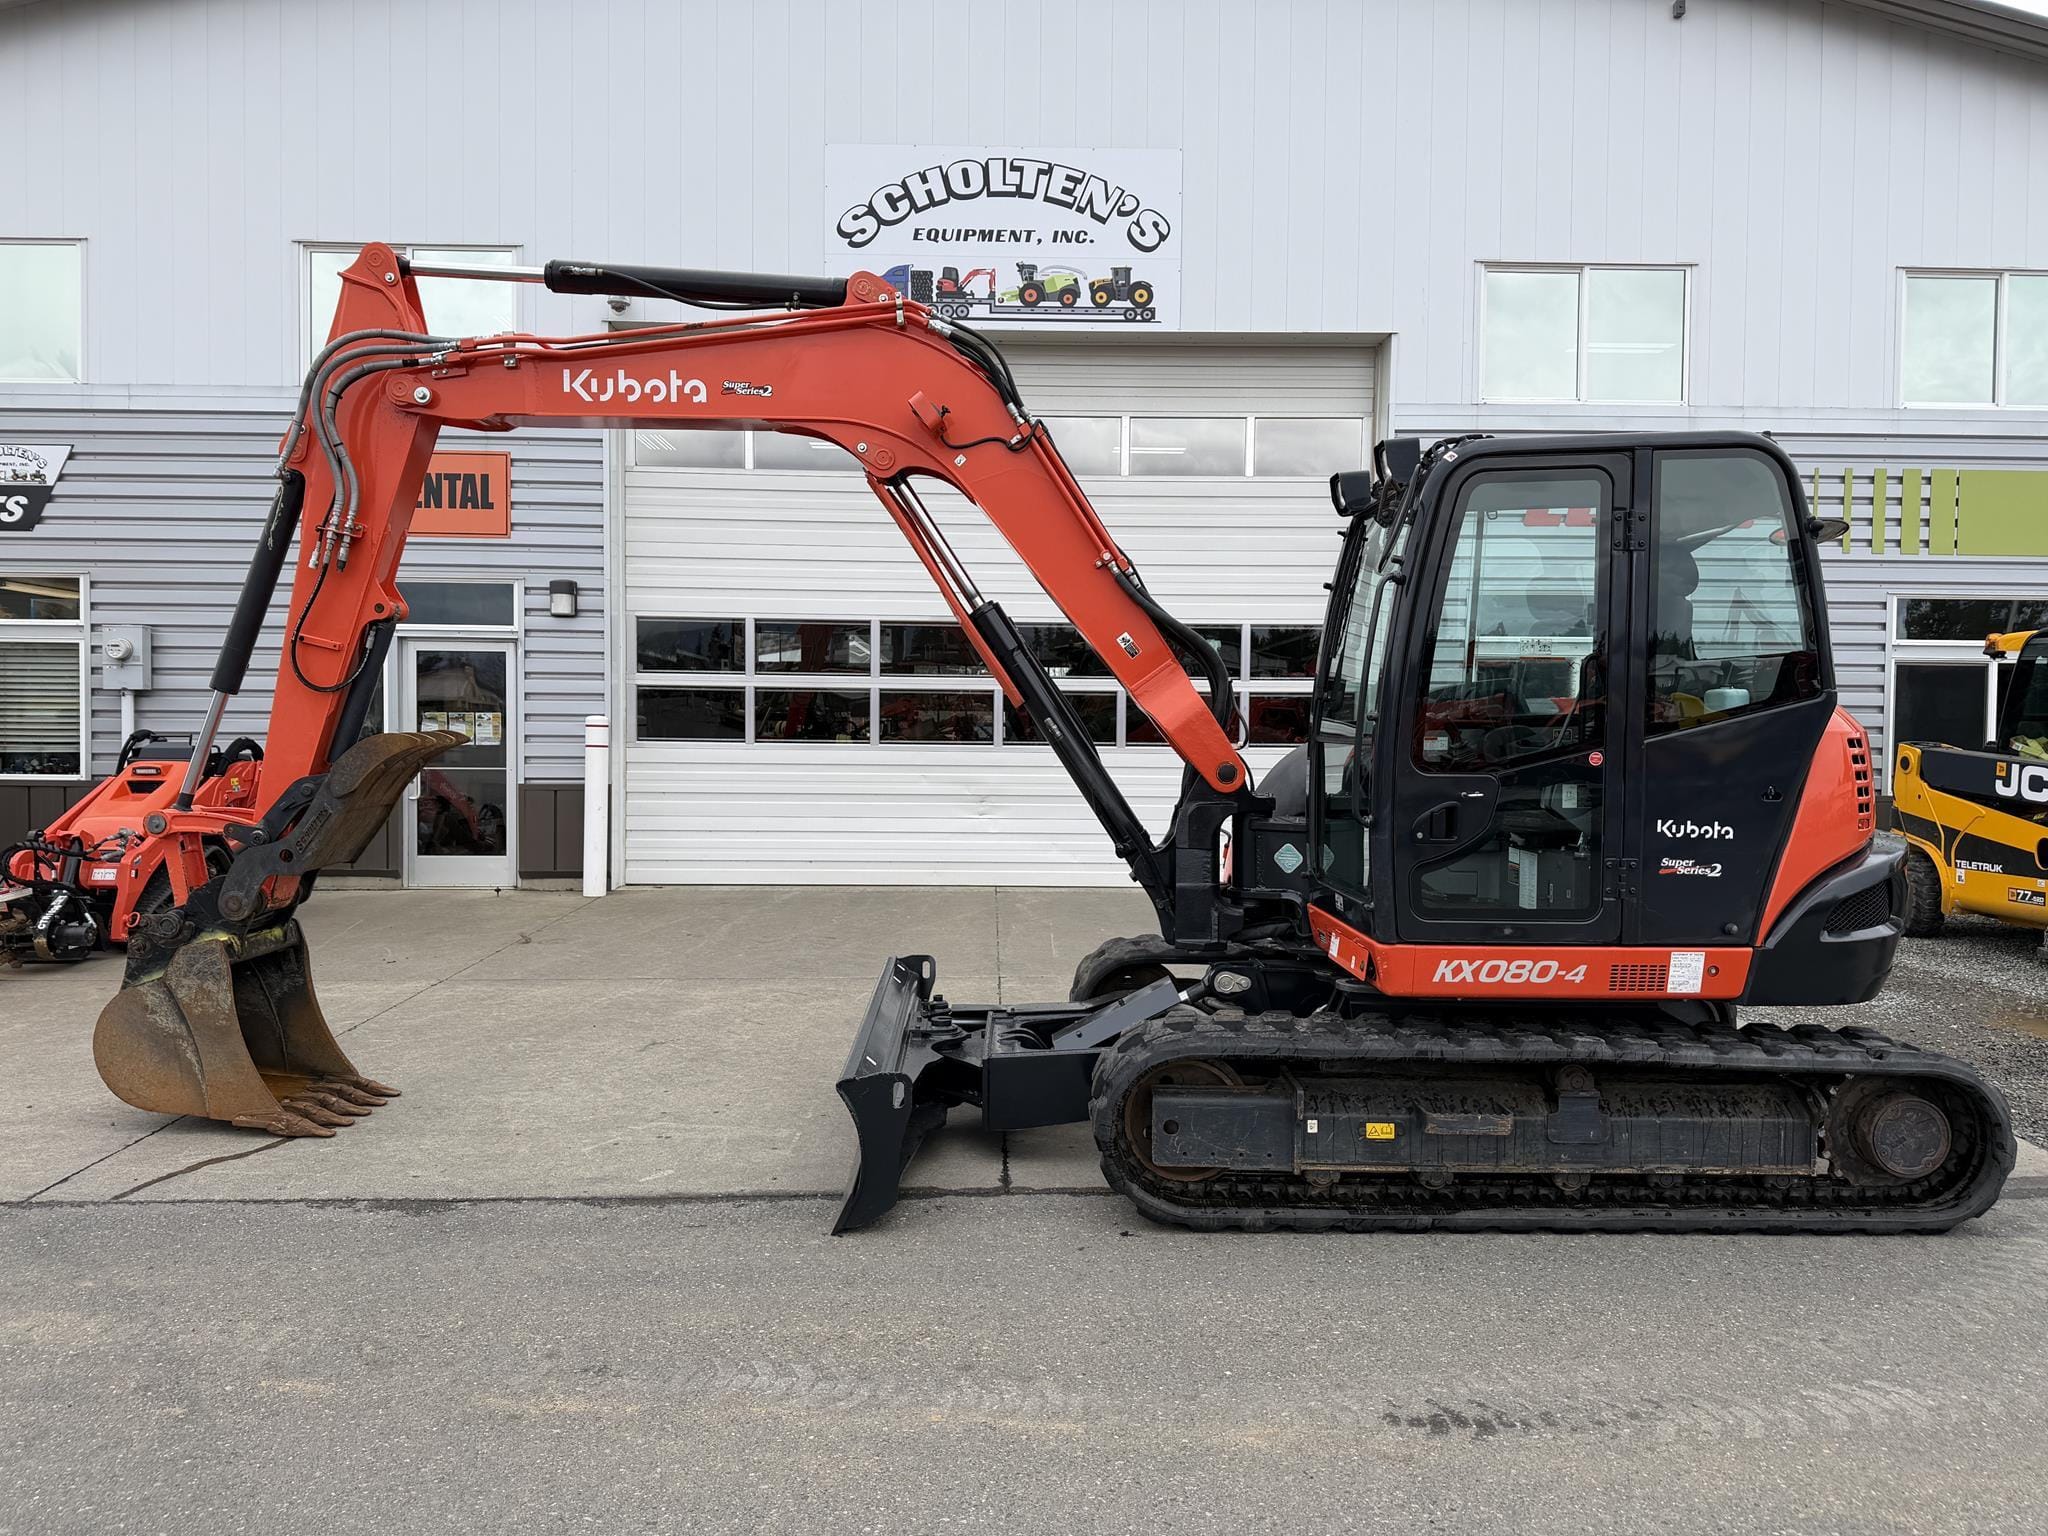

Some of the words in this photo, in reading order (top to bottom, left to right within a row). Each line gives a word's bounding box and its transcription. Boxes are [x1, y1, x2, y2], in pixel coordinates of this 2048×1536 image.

[836, 157, 1171, 252] SCHOLTEN'S
[912, 228, 1043, 245] EQUIPMENT,
[1052, 231, 1096, 244] INC.
[562, 368, 707, 403] Kubota
[723, 380, 751, 390] Super
[416, 473, 494, 509] NTAL
[1657, 819, 1734, 839] Kubota
[1661, 858, 1695, 868] Super
[1956, 859, 2003, 873] TELETRUK
[1432, 959, 1588, 984] KX080-4
